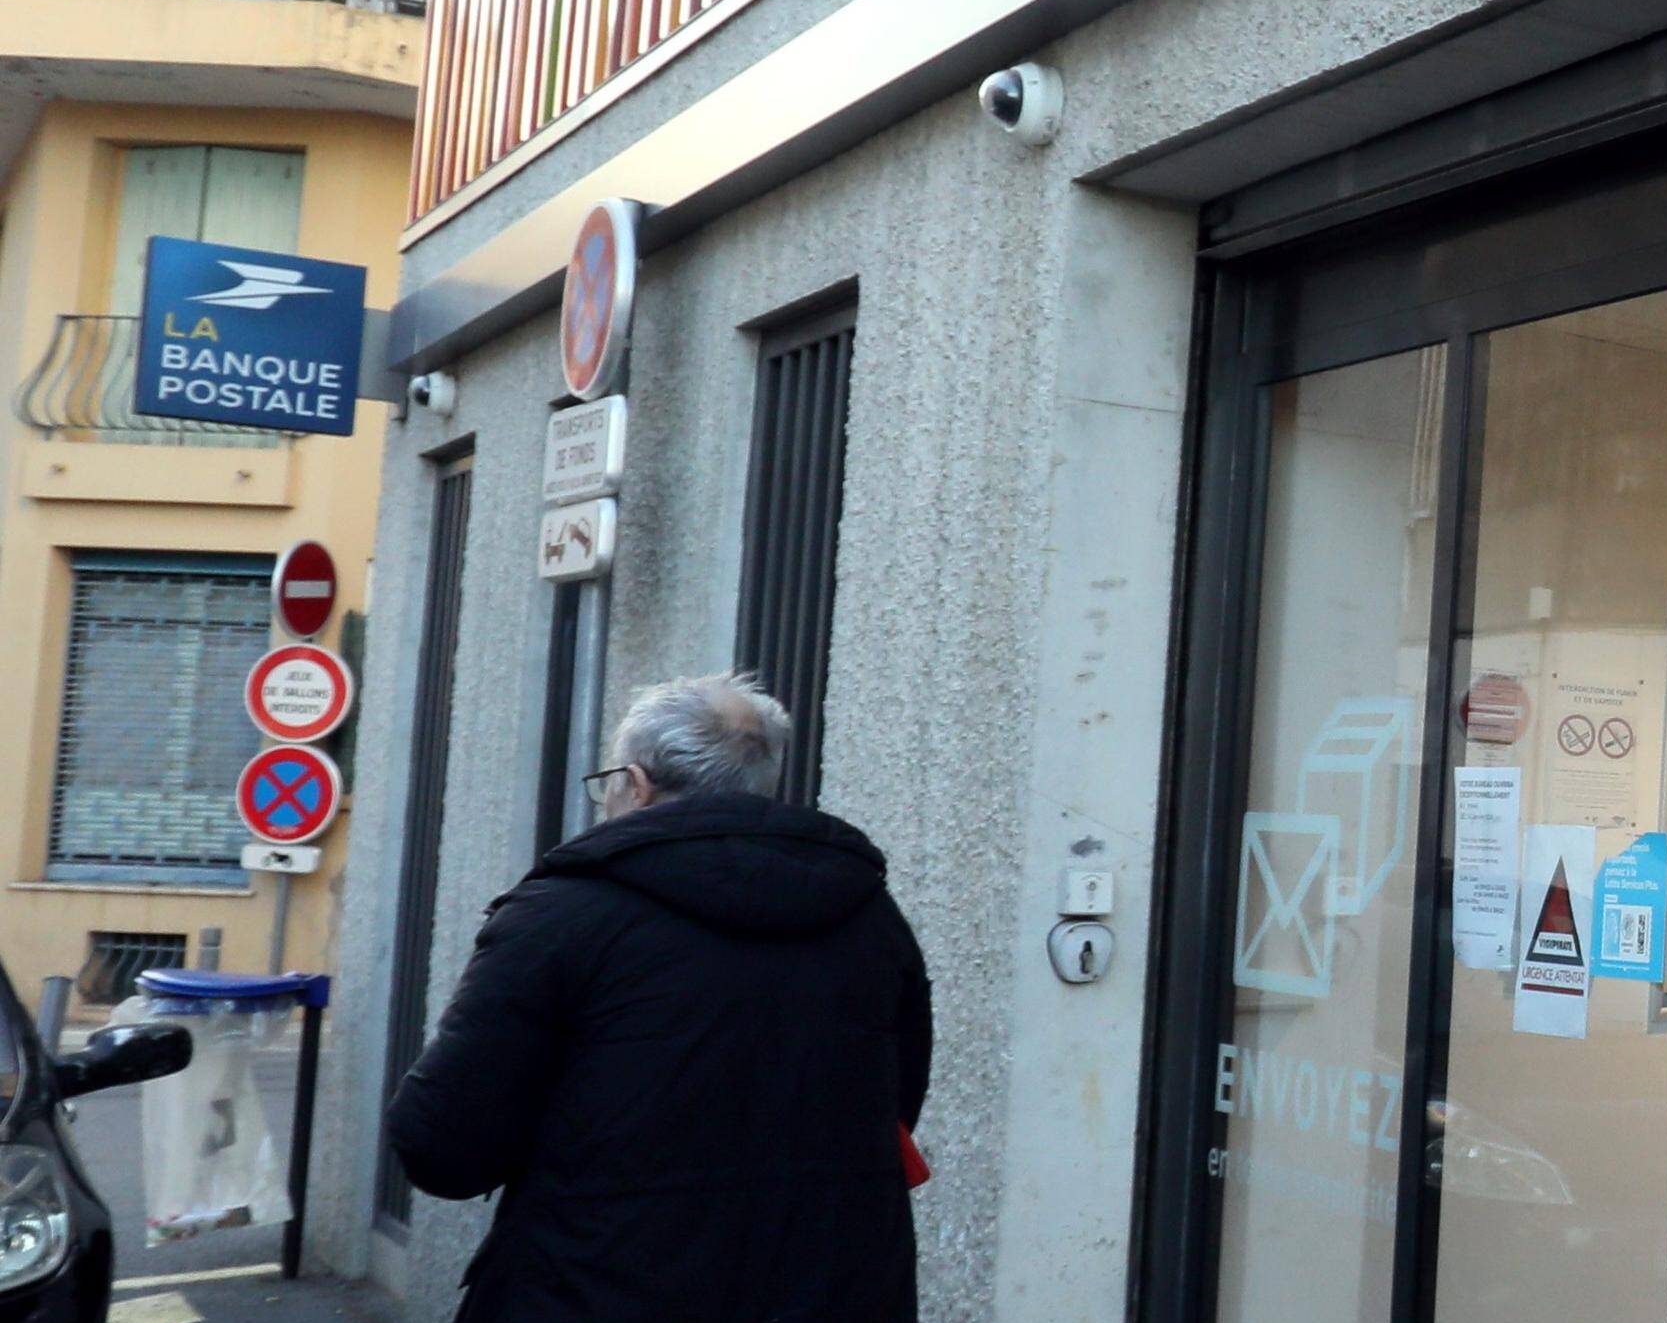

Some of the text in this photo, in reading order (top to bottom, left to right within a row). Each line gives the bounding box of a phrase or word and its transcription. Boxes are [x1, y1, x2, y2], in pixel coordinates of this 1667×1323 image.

[164, 312, 218, 342] LA
[161, 343, 343, 388] BANQUE
[158, 375, 339, 419] POSTALE
[1522, 966, 1585, 984] URGENCE ATTENTAT
[1214, 1043, 1402, 1153] ENVOYEZ
